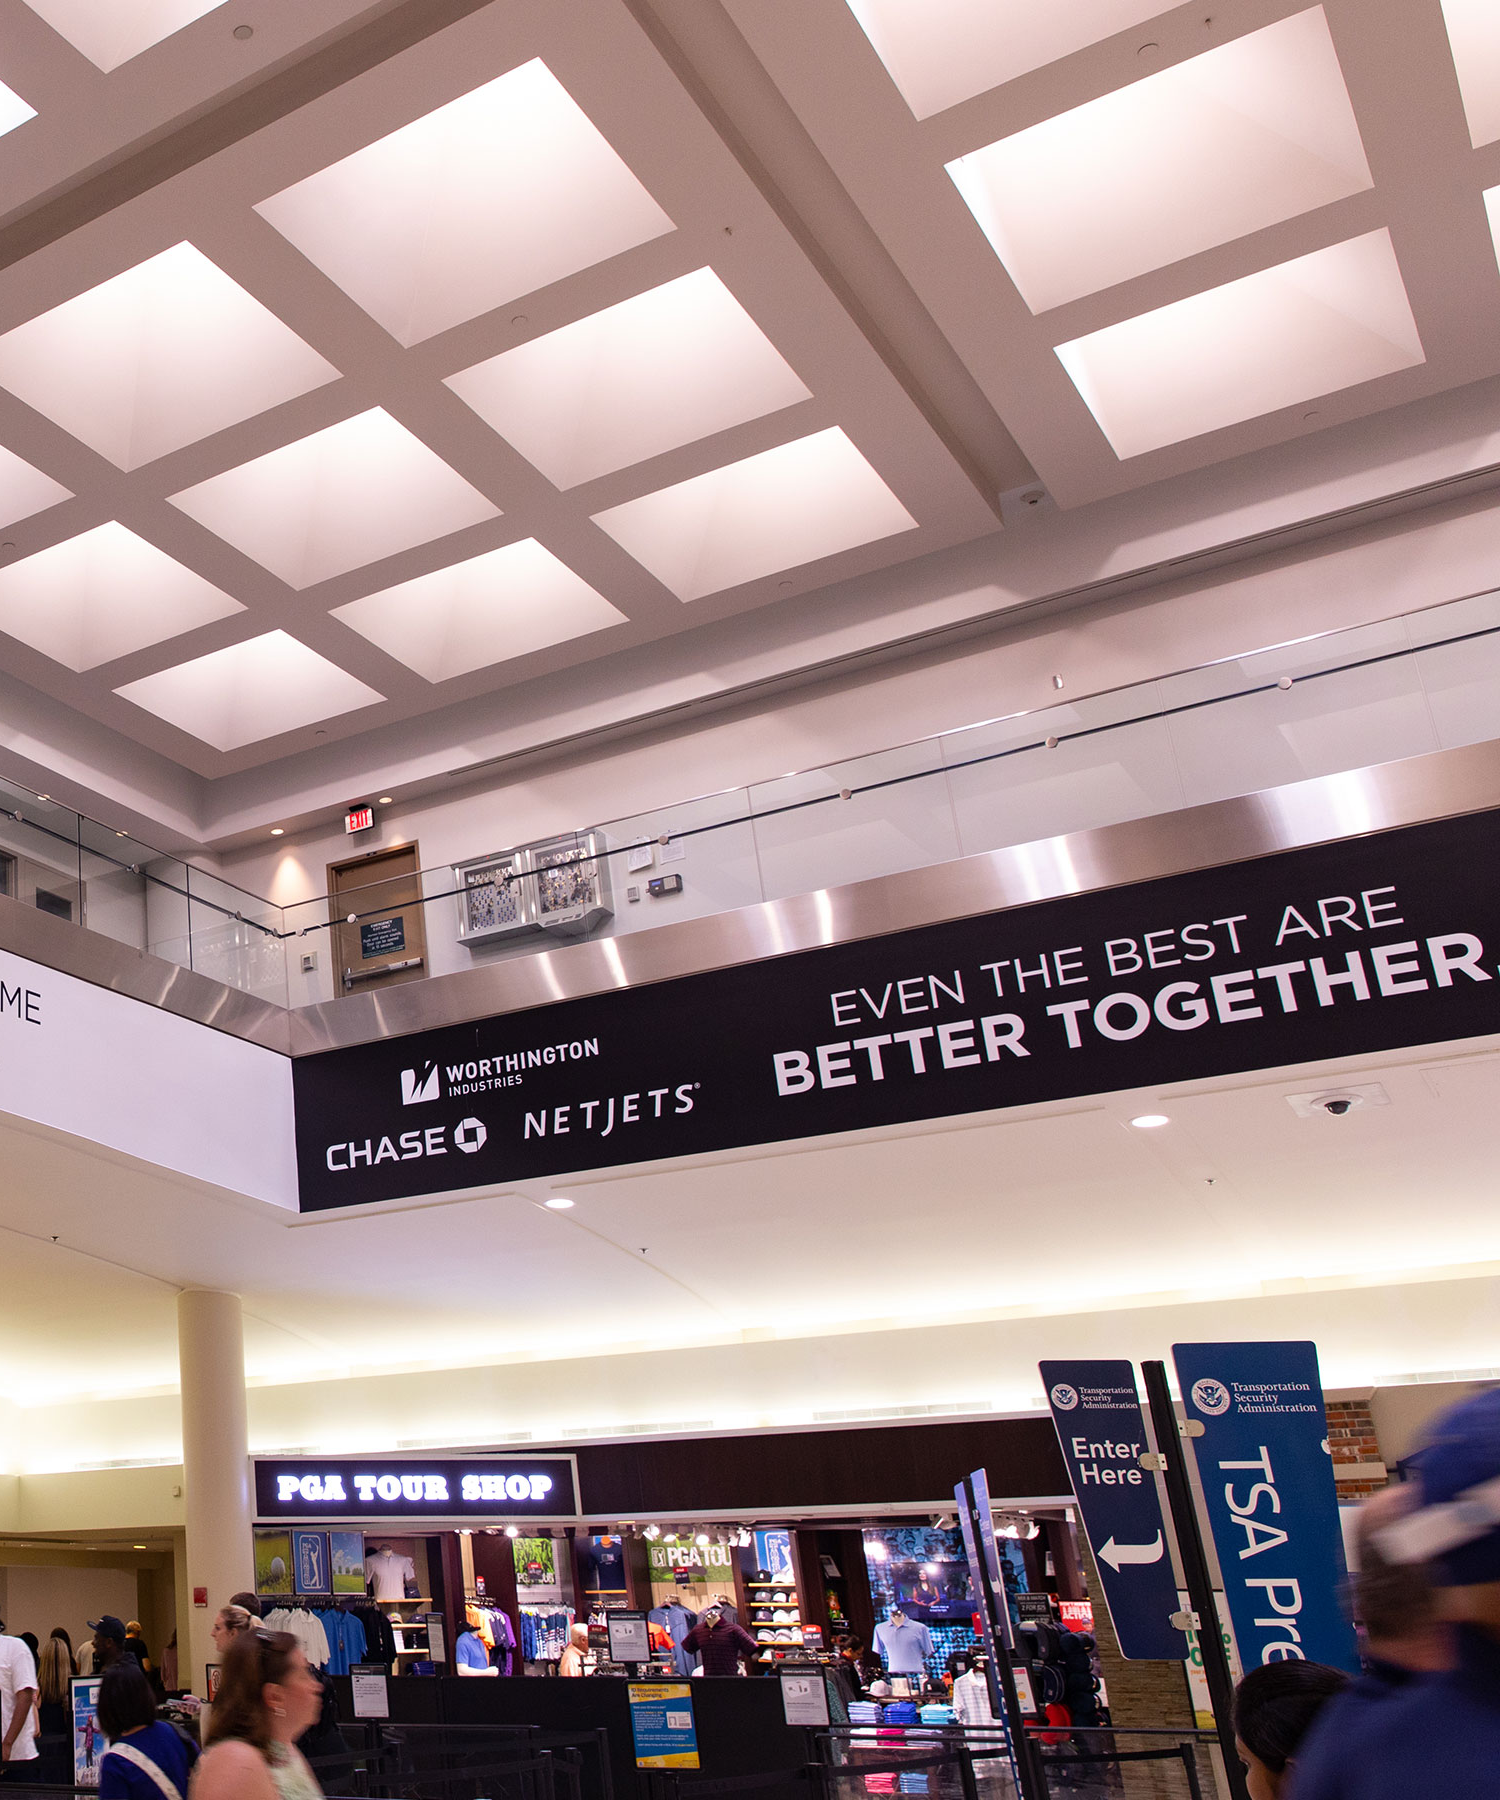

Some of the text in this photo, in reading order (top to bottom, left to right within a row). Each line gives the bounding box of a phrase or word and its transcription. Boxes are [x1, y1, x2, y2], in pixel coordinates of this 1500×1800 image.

[350, 810, 369, 831] EXIT
[830, 886, 1405, 1027] EVEN THE BEST ARE
[773, 932, 1500, 1097] BETTER TOGETHER
[446, 1038, 600, 1083] WORTHINGTON
[449, 1074, 523, 1097] INDUSTRIES
[326, 1126, 448, 1172] CHASE
[1078, 1386, 1134, 1395] Transportation
[1080, 1394, 1112, 1402] Security
[1230, 1382, 1311, 1393] Transportation
[1234, 1392, 1278, 1404] Security
[1082, 1402, 1138, 1410] Administration
[1237, 1402, 1318, 1412] Administration
[1071, 1437, 1140, 1459] Enter
[1079, 1463, 1143, 1485] Here
[277, 1473, 553, 1501] PGA TOUR SHOP
[1218, 1445, 1289, 1560] TSA
[666, 1546, 732, 1567] PGA TOU
